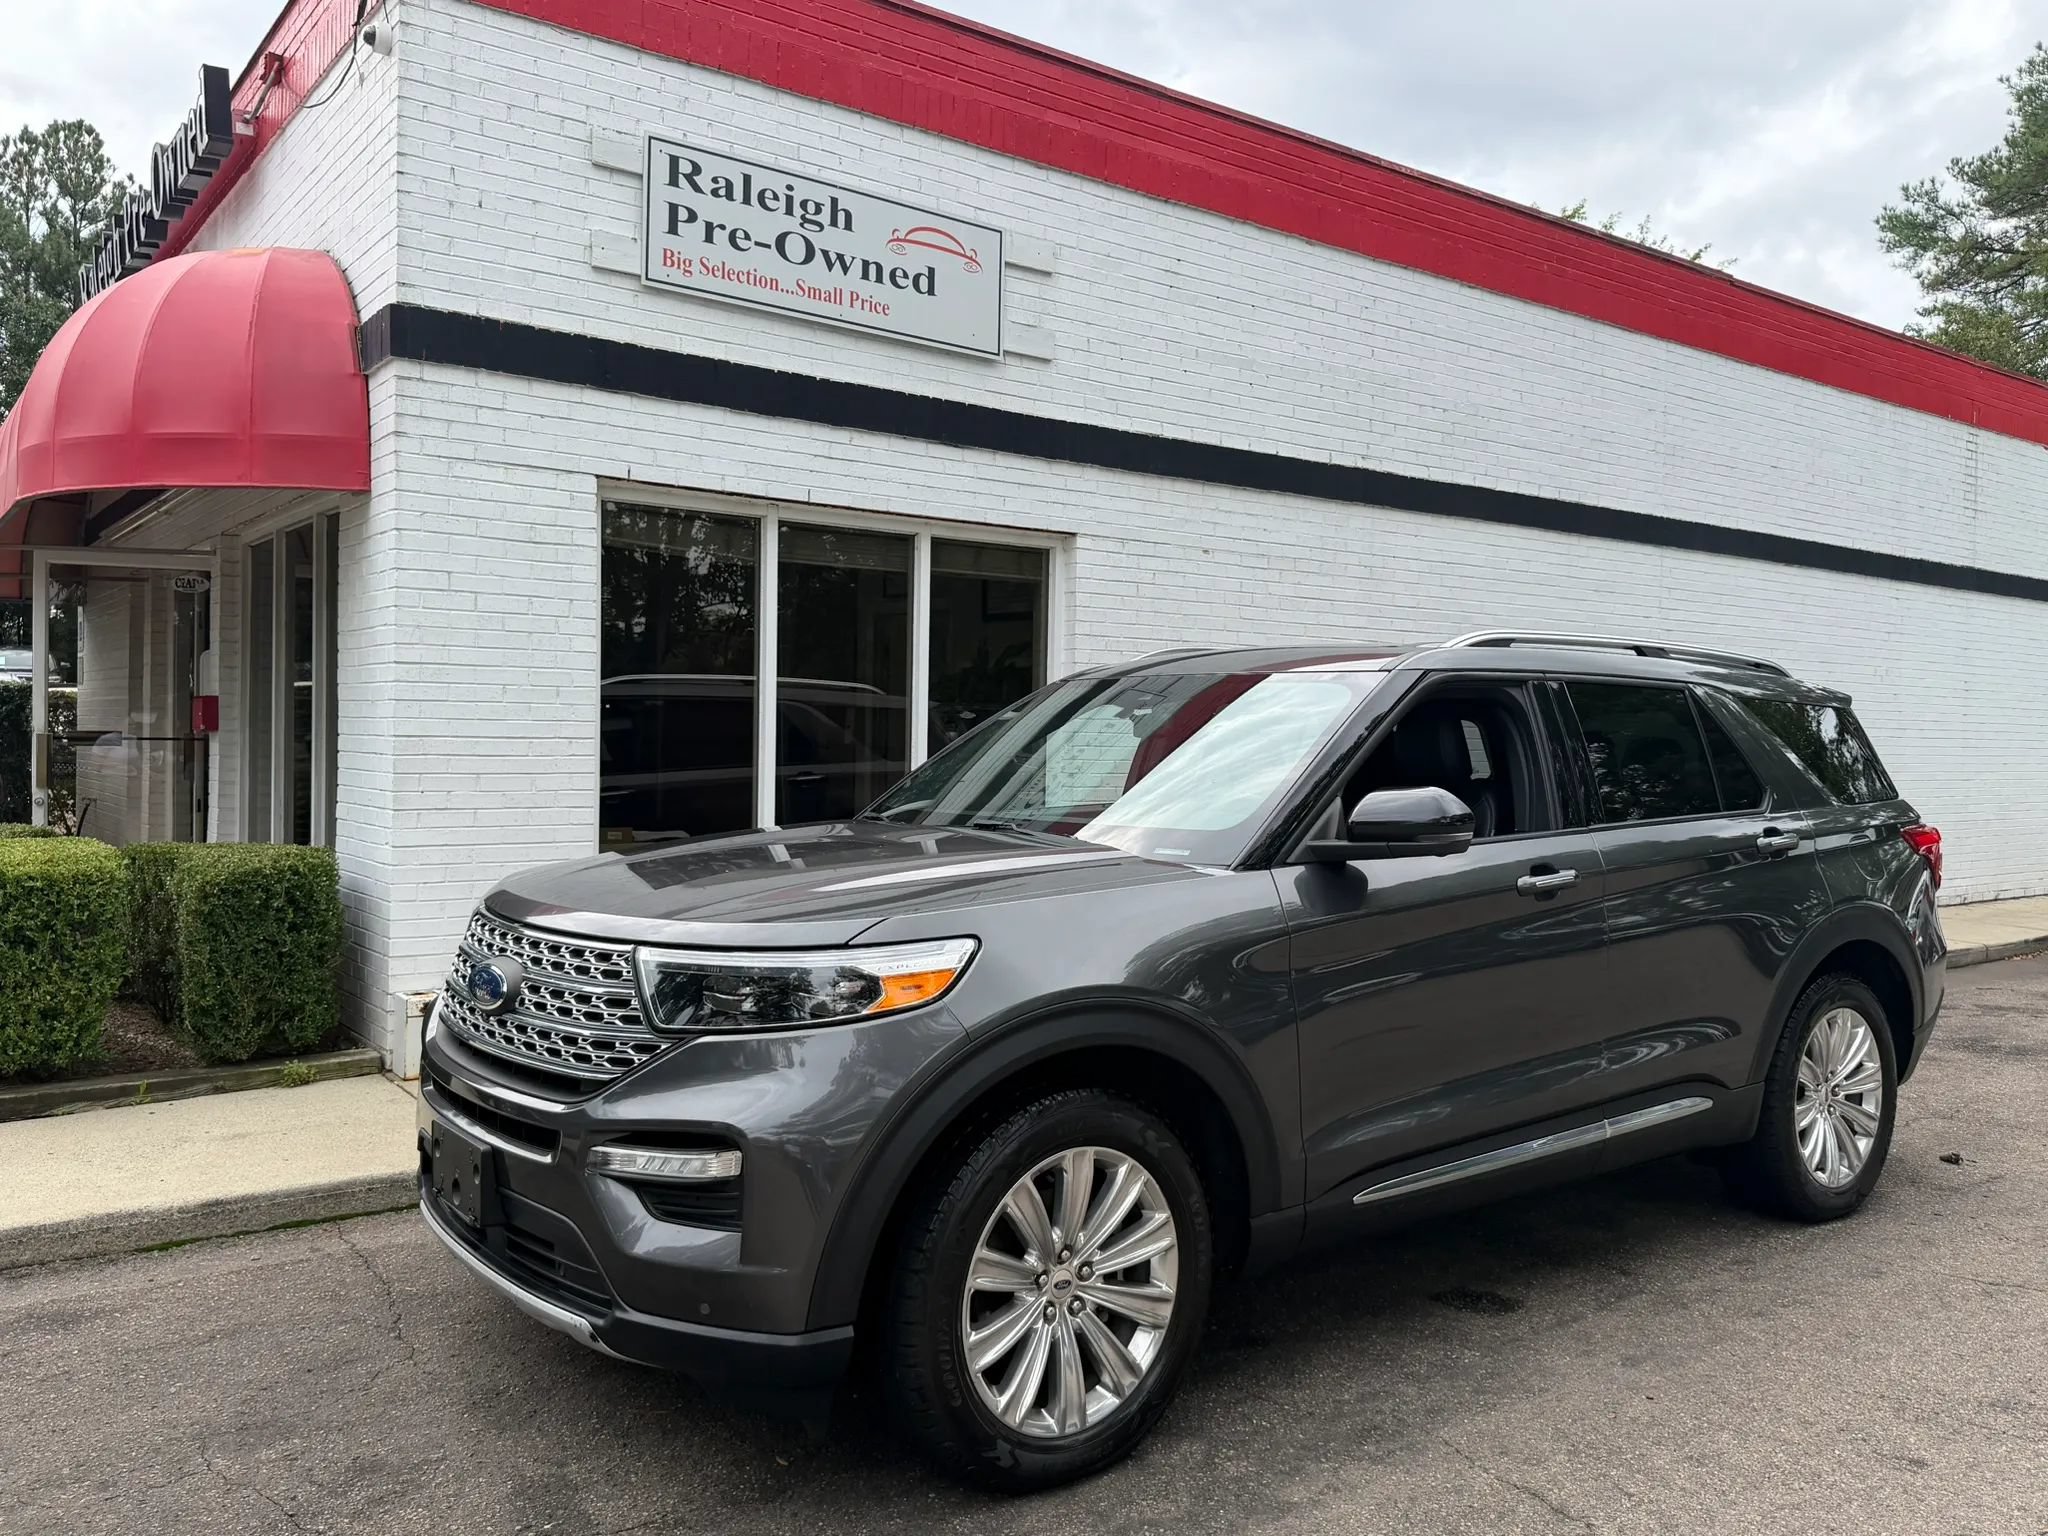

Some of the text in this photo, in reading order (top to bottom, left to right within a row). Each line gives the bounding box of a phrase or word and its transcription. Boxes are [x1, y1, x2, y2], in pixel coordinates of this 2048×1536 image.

[664, 152, 855, 233] Raleigh
[661, 247, 694, 278] Big
[849, 293, 891, 317] Price
[663, 200, 938, 297] Pre-Owned
